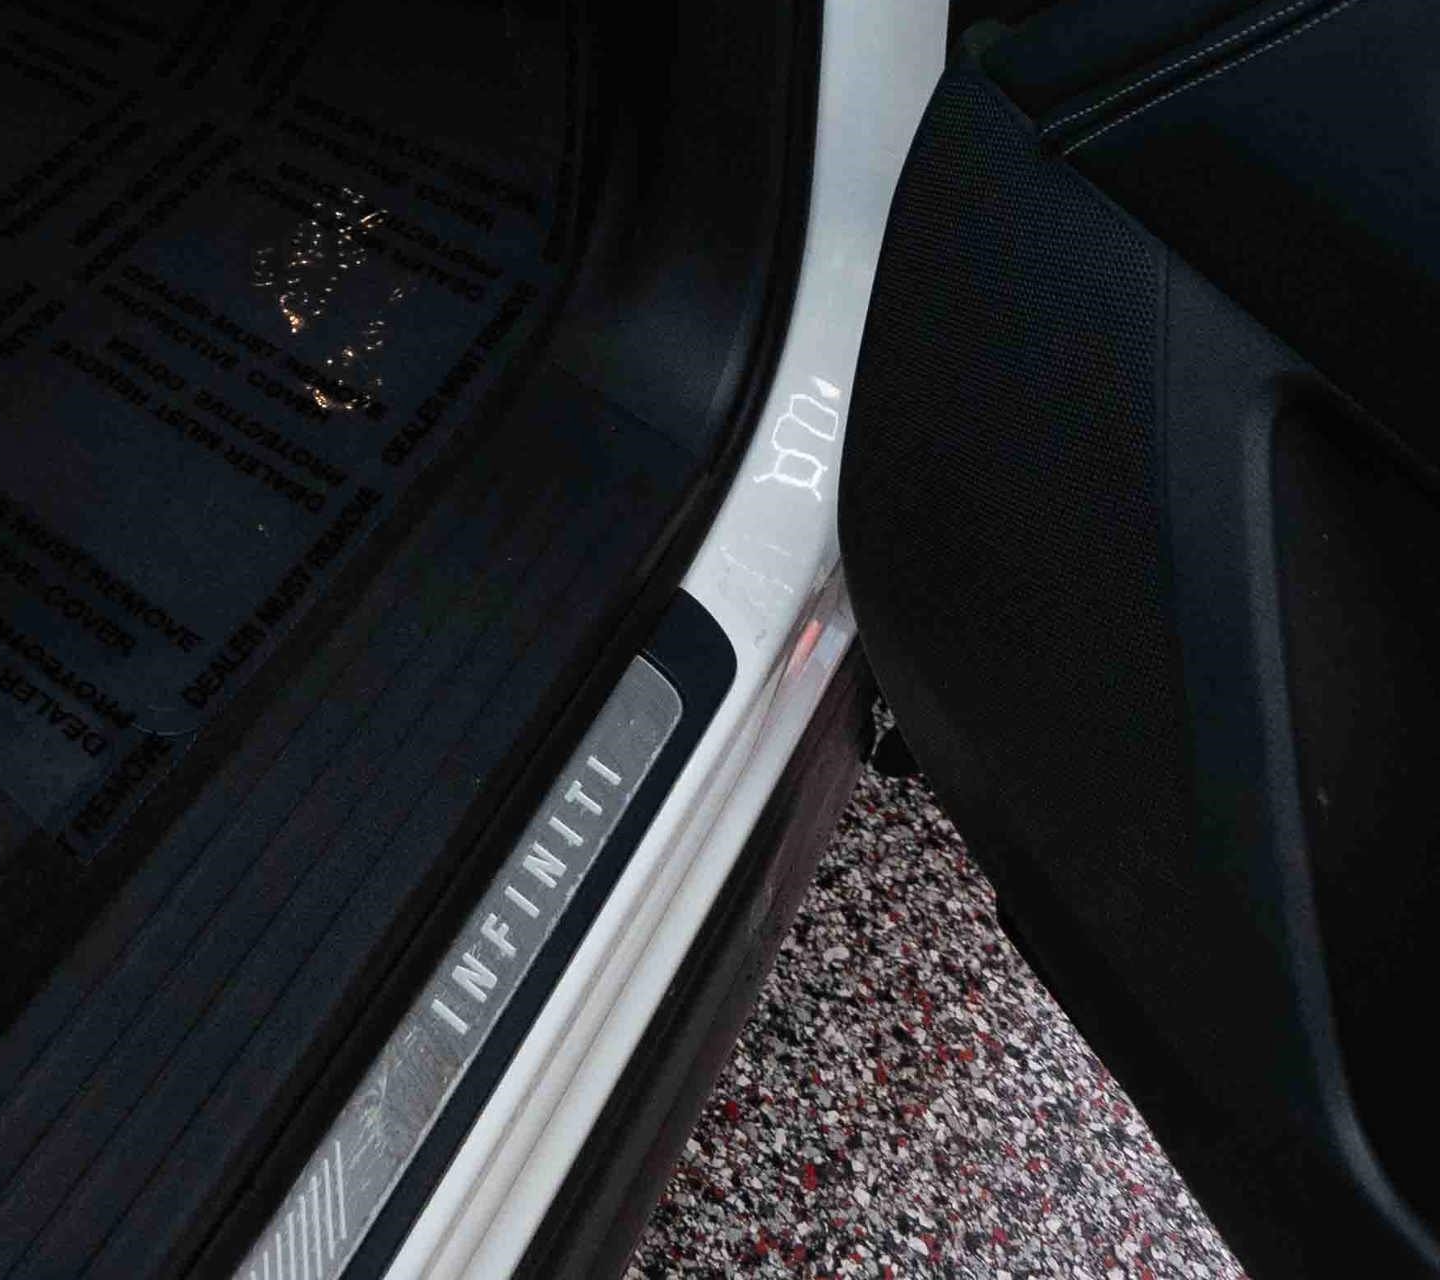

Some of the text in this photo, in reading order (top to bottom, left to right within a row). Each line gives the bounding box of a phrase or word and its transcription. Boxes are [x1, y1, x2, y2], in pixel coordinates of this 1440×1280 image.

[151, 404, 223, 451] MUST
[224, 446, 325, 513] DEALER
[9, 515, 90, 571] MUST
[85, 565, 201, 652] REMOVE
[43, 585, 136, 657] COVER
[181, 624, 265, 709] DEALER
[256, 565, 311, 627] MUST
[72, 733, 172, 838] REMOVE
[431, 755, 622, 1036] INFINITI
